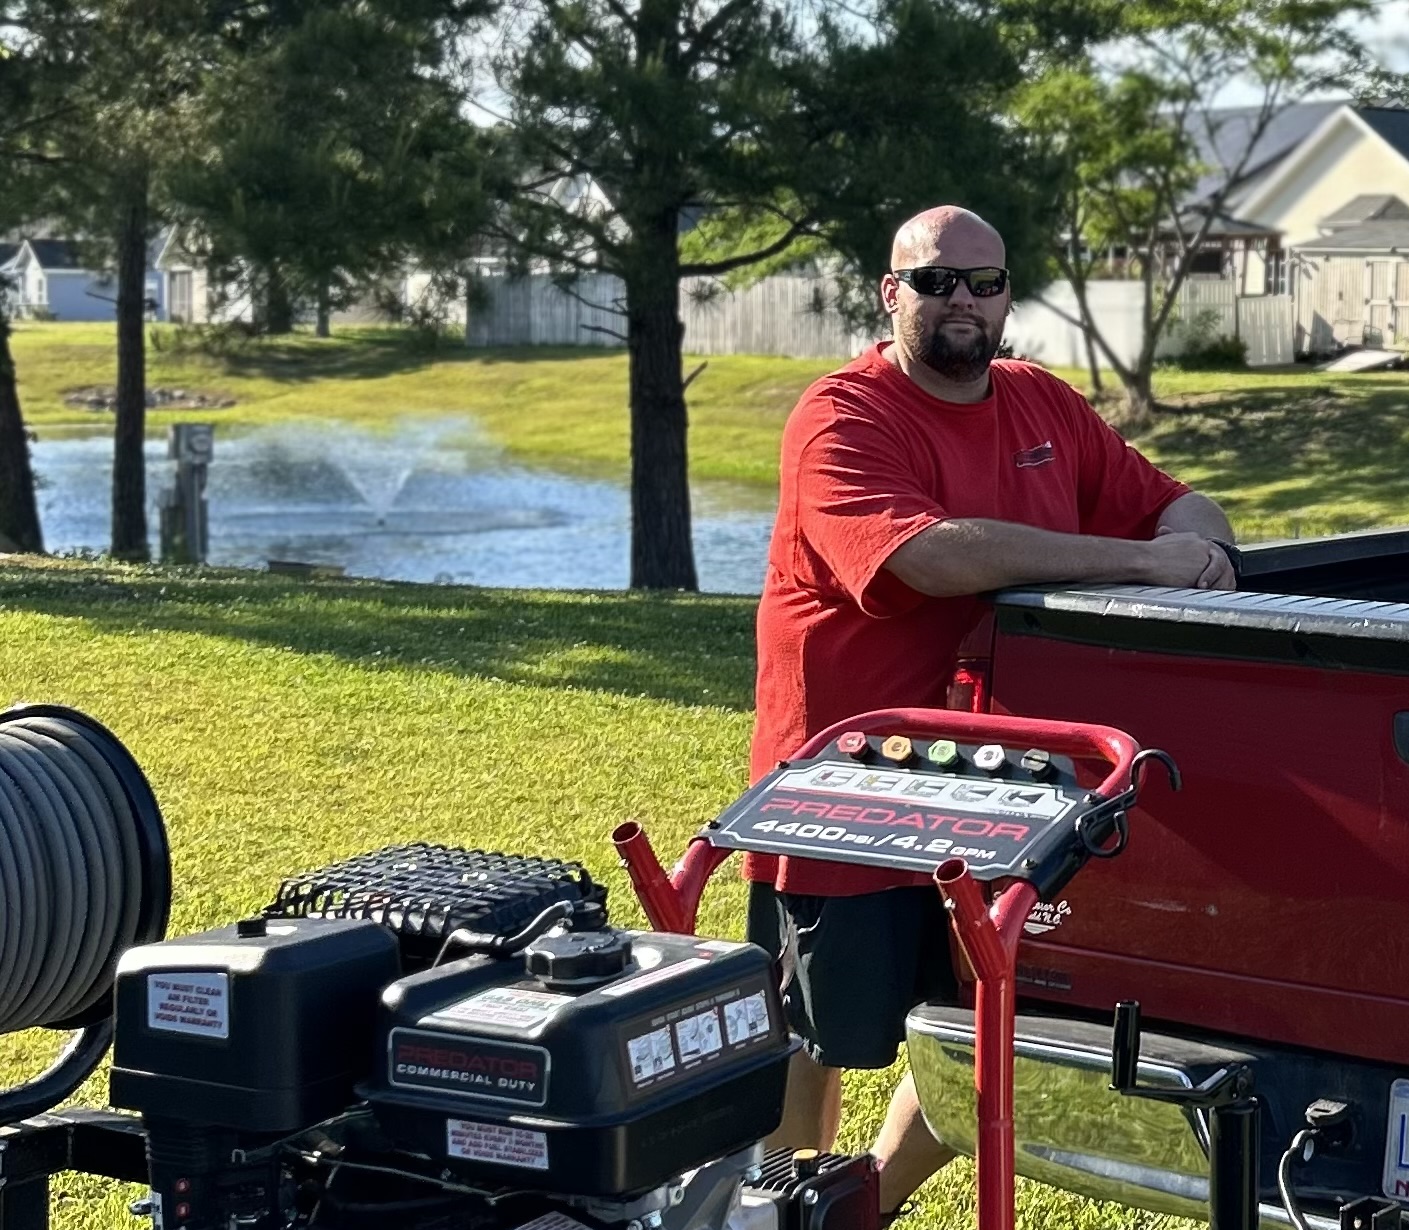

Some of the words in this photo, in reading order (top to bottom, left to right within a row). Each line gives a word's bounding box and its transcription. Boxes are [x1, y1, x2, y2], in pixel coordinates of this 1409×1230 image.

[760, 798, 1030, 842] PREDATOR
[398, 1046, 537, 1077] PREDATOR
[397, 1064, 492, 1085] COMMERCIAL
[498, 1077, 536, 1091] DUTY
